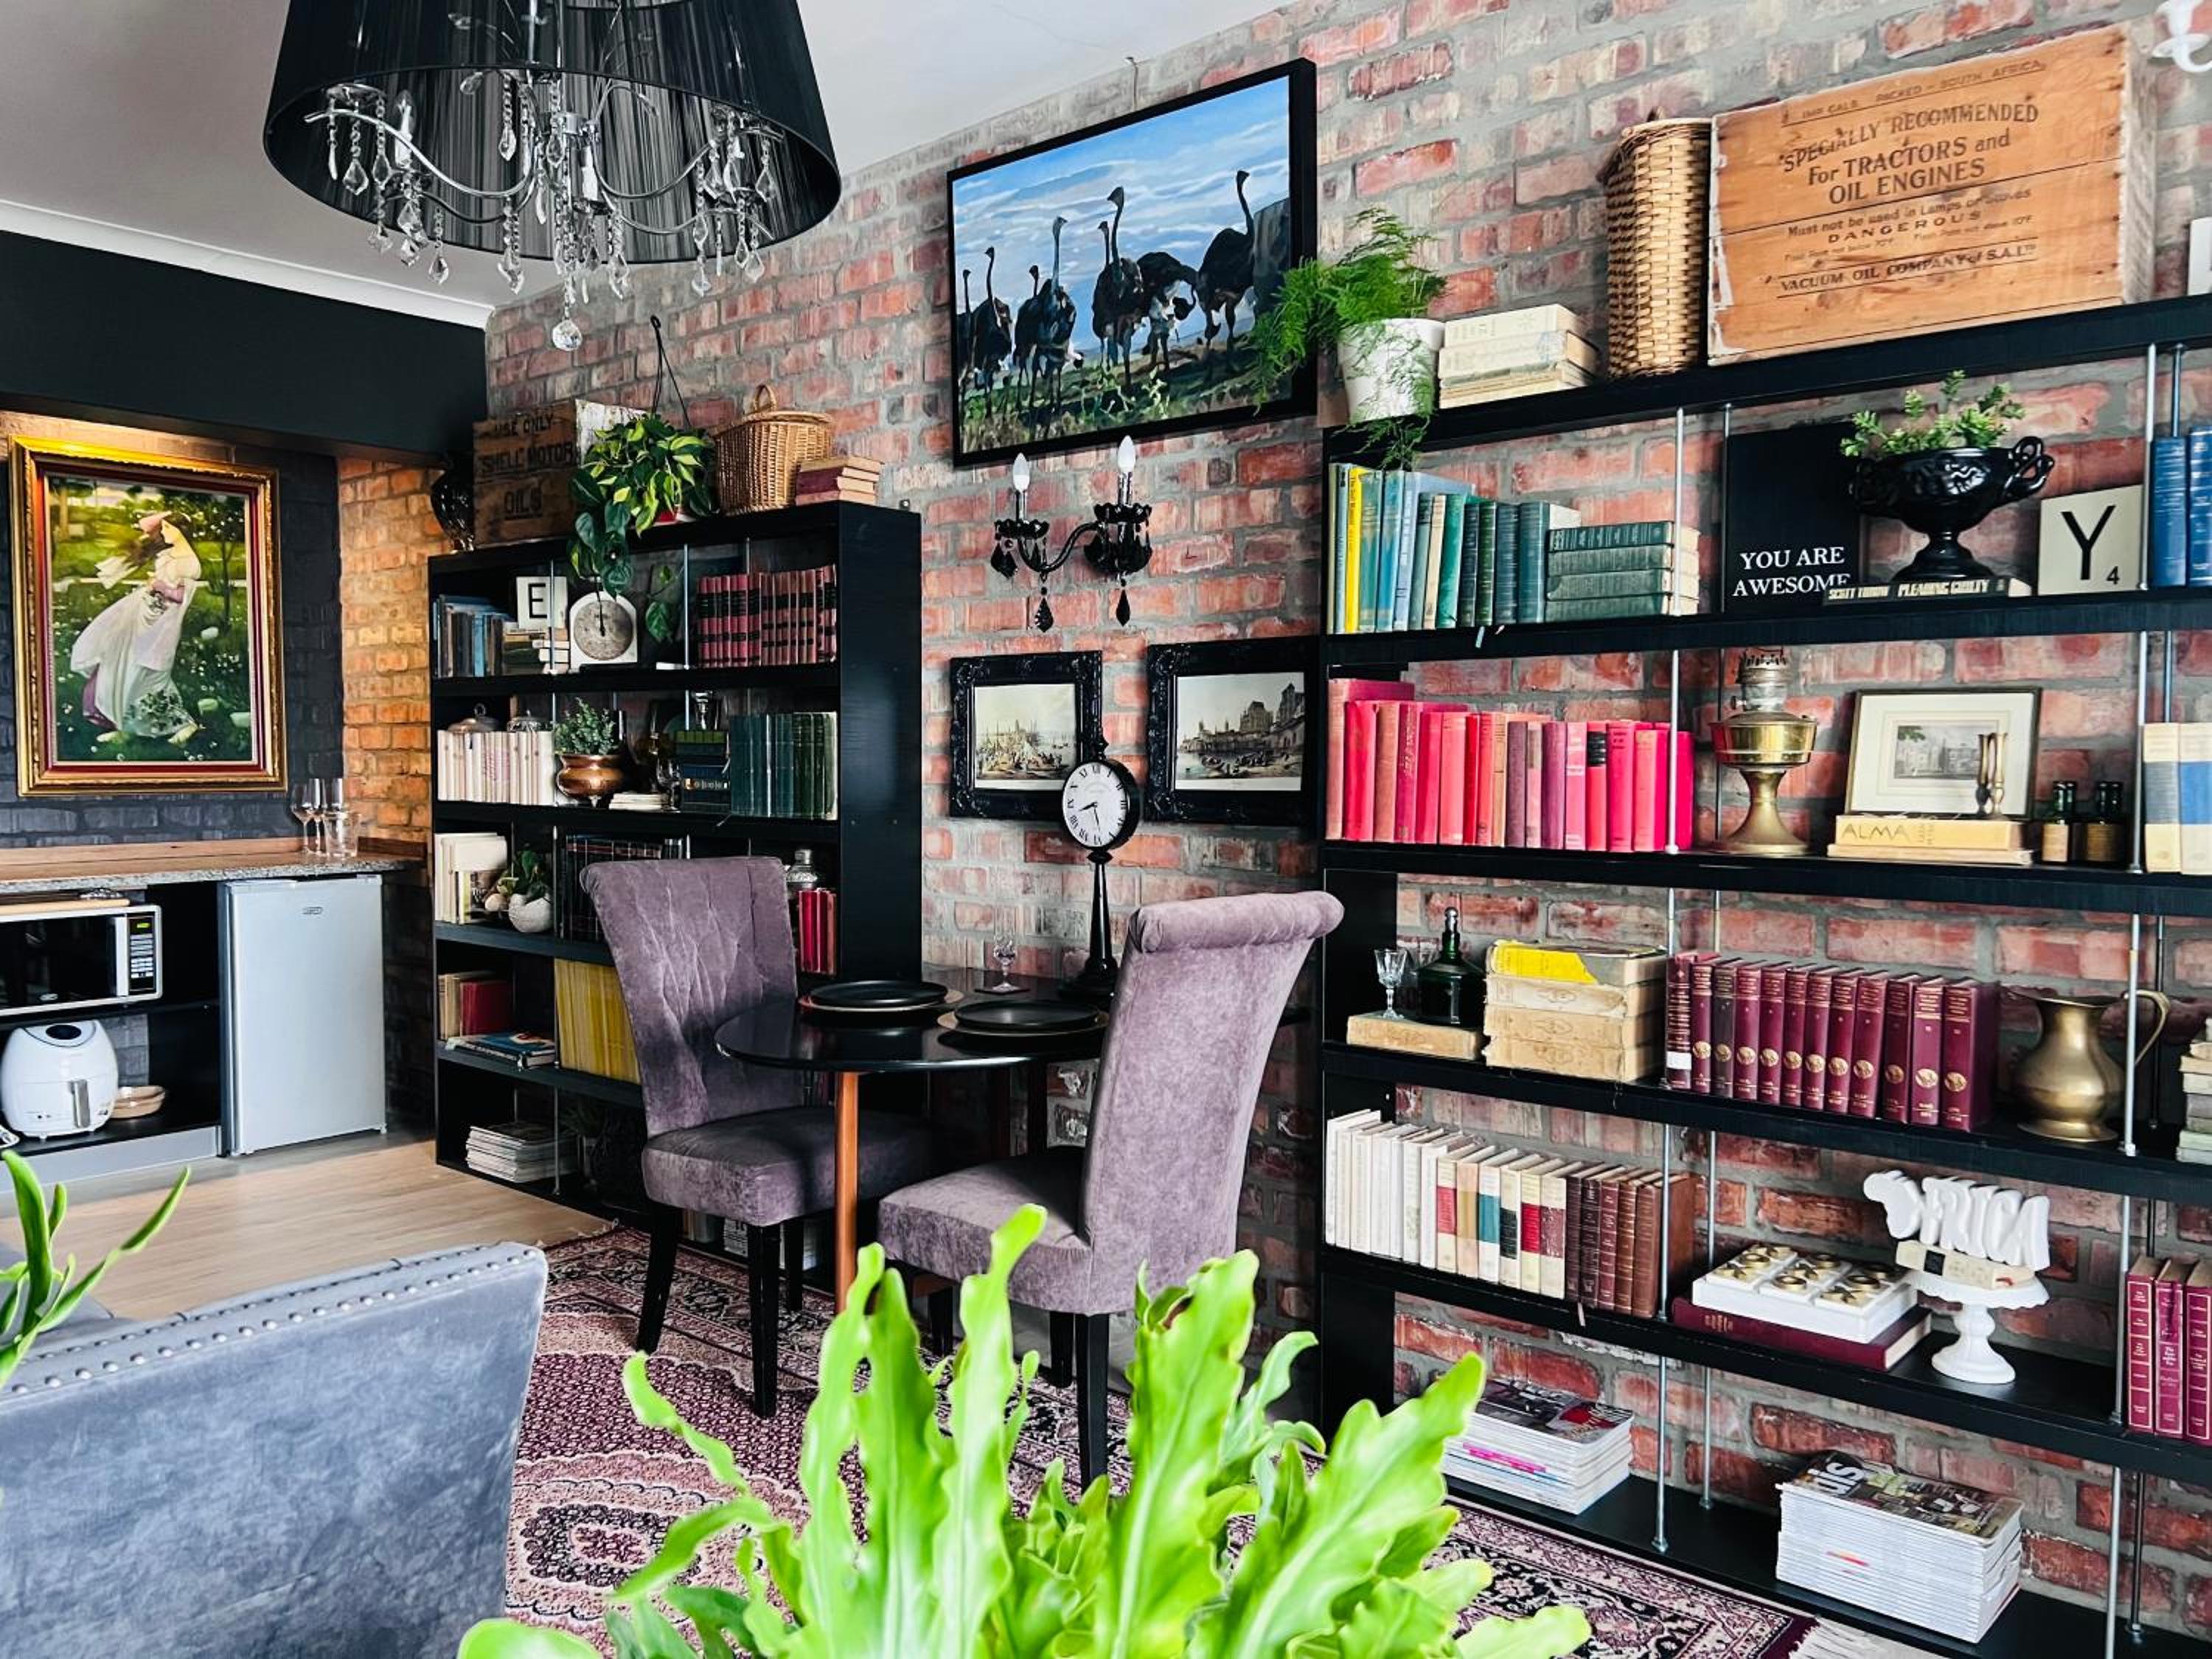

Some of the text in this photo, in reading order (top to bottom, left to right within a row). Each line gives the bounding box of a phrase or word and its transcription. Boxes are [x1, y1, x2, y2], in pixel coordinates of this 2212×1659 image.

[1891, 103, 2040, 134] RECOMMENDED
[1808, 127, 2011, 186] For TRACTORS and
[1829, 157, 1986, 204] OIL ENGINES
[1788, 224, 1818, 237] Must
[1821, 220, 1843, 232] not
[1848, 215, 1863, 227] be
[1868, 209, 1900, 223] used
[1921, 201, 1962, 216] Lamps
[1828, 209, 1981, 244] DANGEROUS
[1781, 272, 1844, 291] VACUUM
[1852, 267, 1880, 281] OIL
[1886, 253, 1966, 276] COMPANY
[523, 413, 554, 434] ONLY
[504, 487, 543, 514] OILS
[1740, 546, 1844, 570] YOU ARE
[2061, 505, 2121, 585] Y 4
[528, 582, 547, 619] E
[1843, 823, 1911, 844] ALMA
